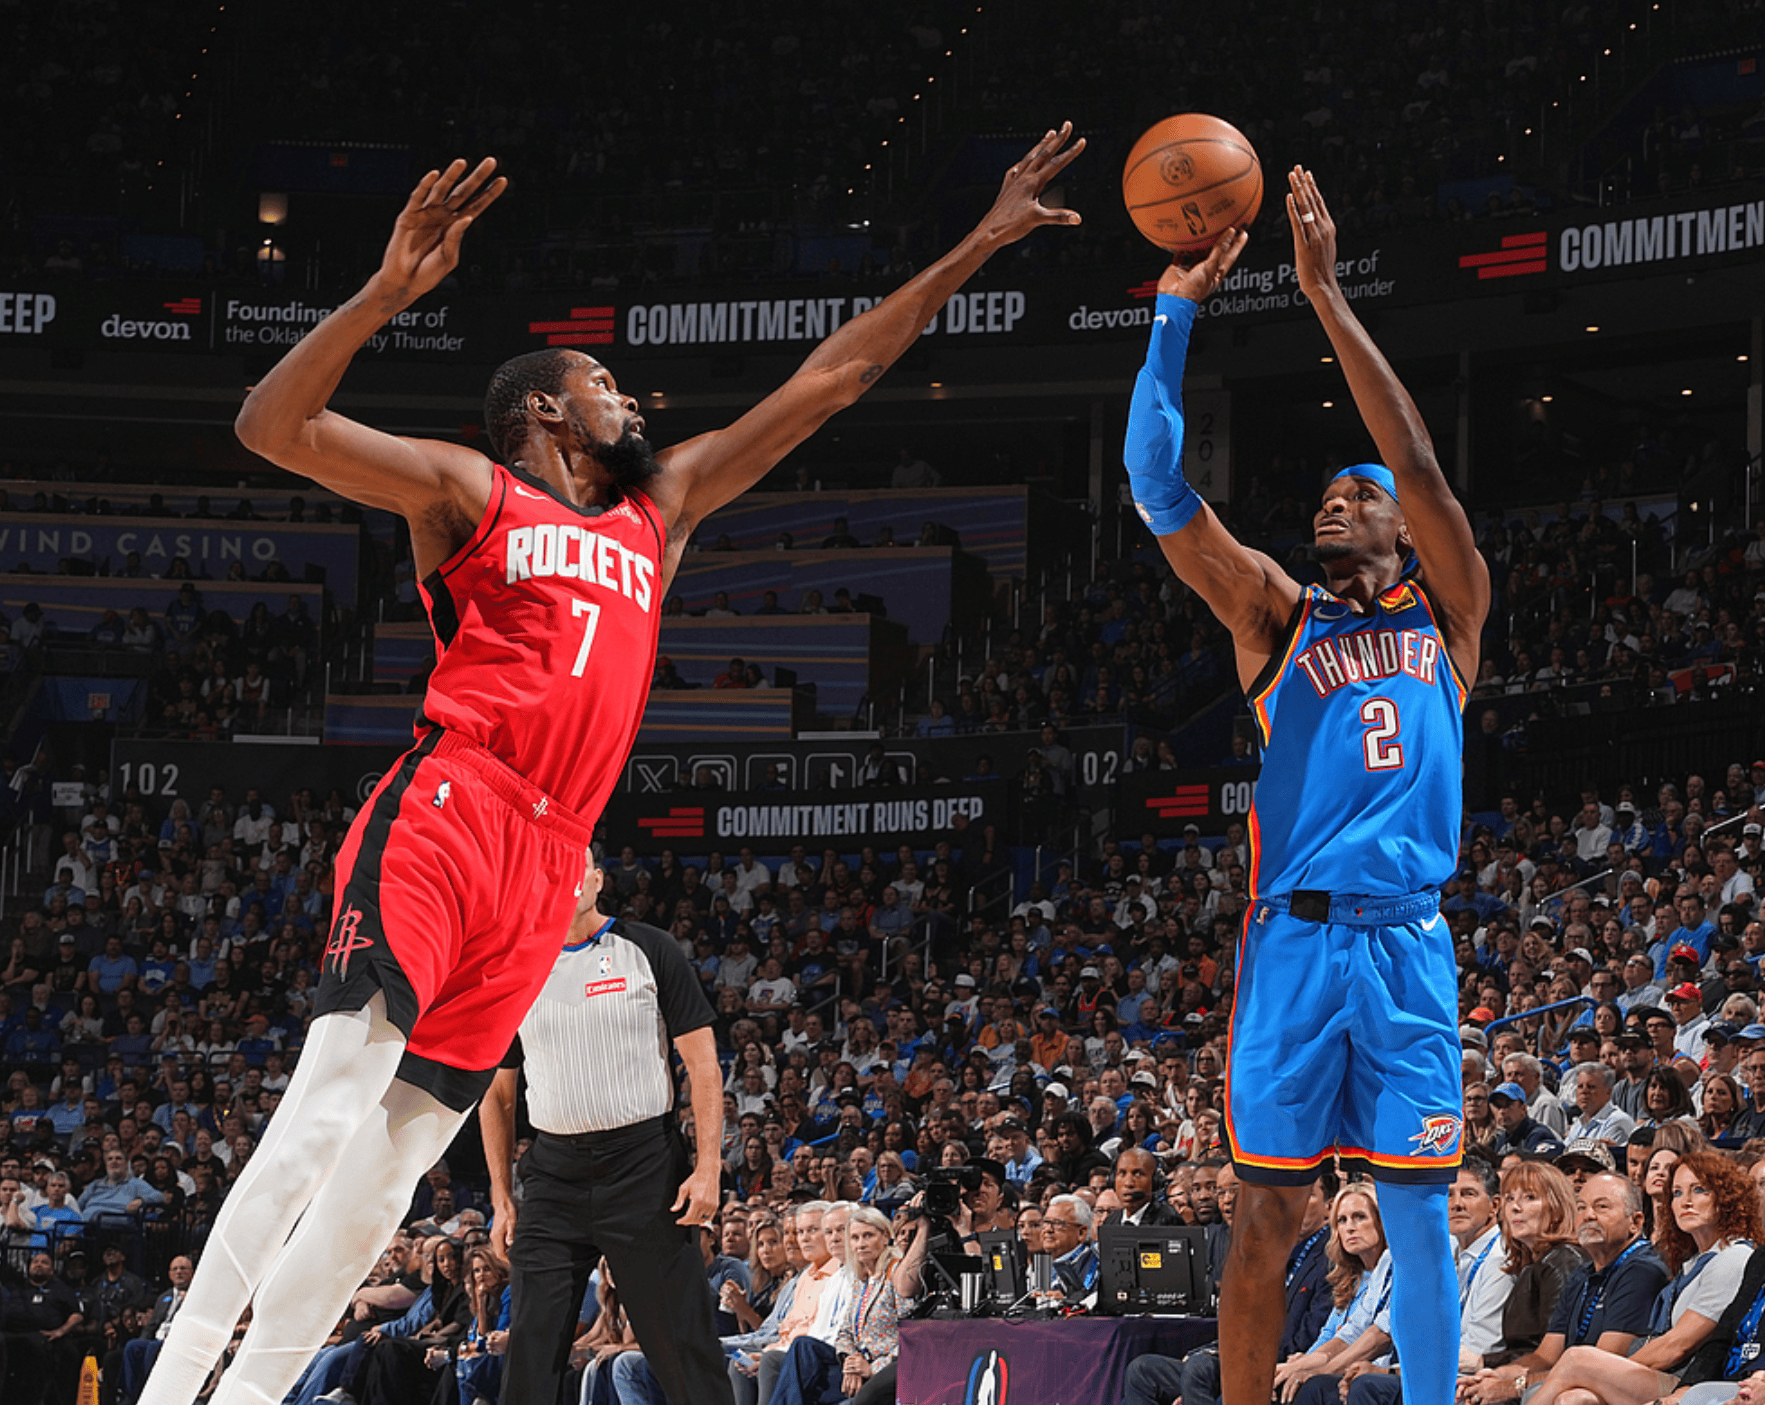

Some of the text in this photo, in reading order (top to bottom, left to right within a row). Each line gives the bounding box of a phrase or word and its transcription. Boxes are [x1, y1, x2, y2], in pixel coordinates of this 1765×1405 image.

[1357, 248, 1381, 272] of
[424, 305, 449, 328] of
[626, 297, 846, 346] COMMITMENT
[945, 290, 1025, 335] DEEP
[1069, 305, 1151, 331] devon
[1209, 294, 1289, 318] Oklahoma
[101, 313, 191, 340] devon
[225, 325, 254, 343] the
[392, 331, 466, 351] Thunder
[1199, 412, 1214, 488] 204
[116, 533, 277, 561] CASINO
[507, 523, 655, 613] ROCKETS
[571, 597, 601, 678] 7
[1294, 628, 1440, 699] THUNDER
[1360, 696, 1404, 772] 2
[119, 762, 179, 796] 102
[716, 796, 984, 838] COMMITMENT RUNS DEEP
